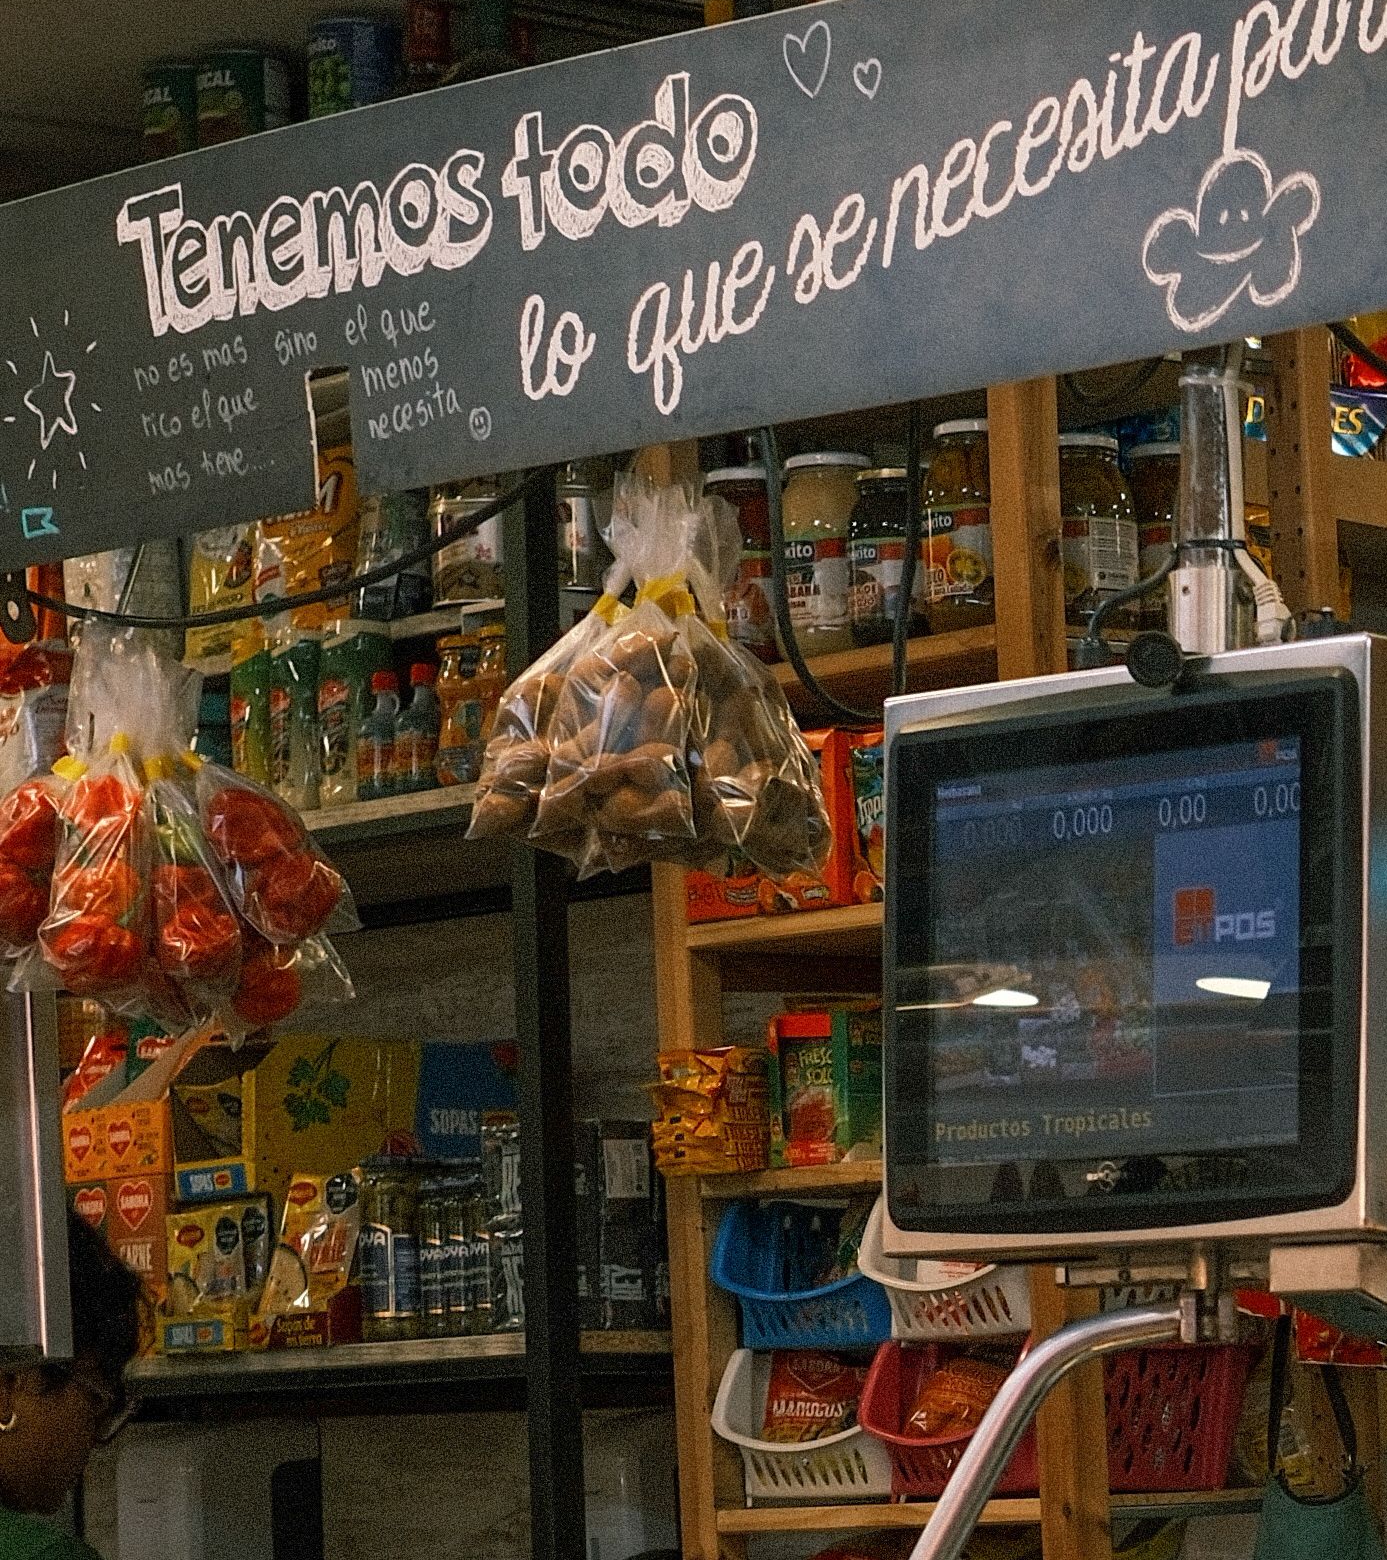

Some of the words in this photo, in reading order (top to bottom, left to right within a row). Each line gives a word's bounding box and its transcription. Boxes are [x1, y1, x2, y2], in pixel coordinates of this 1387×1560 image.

[116, 149, 493, 336] Tenemos
[502, 71, 758, 252] todo
[519, 294, 597, 401] lo
[628, 241, 775, 415] que
[786, 192, 876, 304] se
[884, 31, 1219, 267] necesita
[346, 305, 367, 345] el
[381, 301, 436, 348] que
[134, 365, 159, 391] no
[168, 354, 193, 382] es
[361, 347, 440, 397] menos
[191, 389, 212, 429] el
[217, 388, 258, 432] que
[368, 382, 463, 440] necesita
[1052, 804, 1113, 840] 0,000
[1158, 794, 1207, 828] 0,00
[1215, 910, 1276, 941] POS
[936, 1119, 1031, 1143] Productos
[1043, 1107, 1154, 1136] Tropicales
